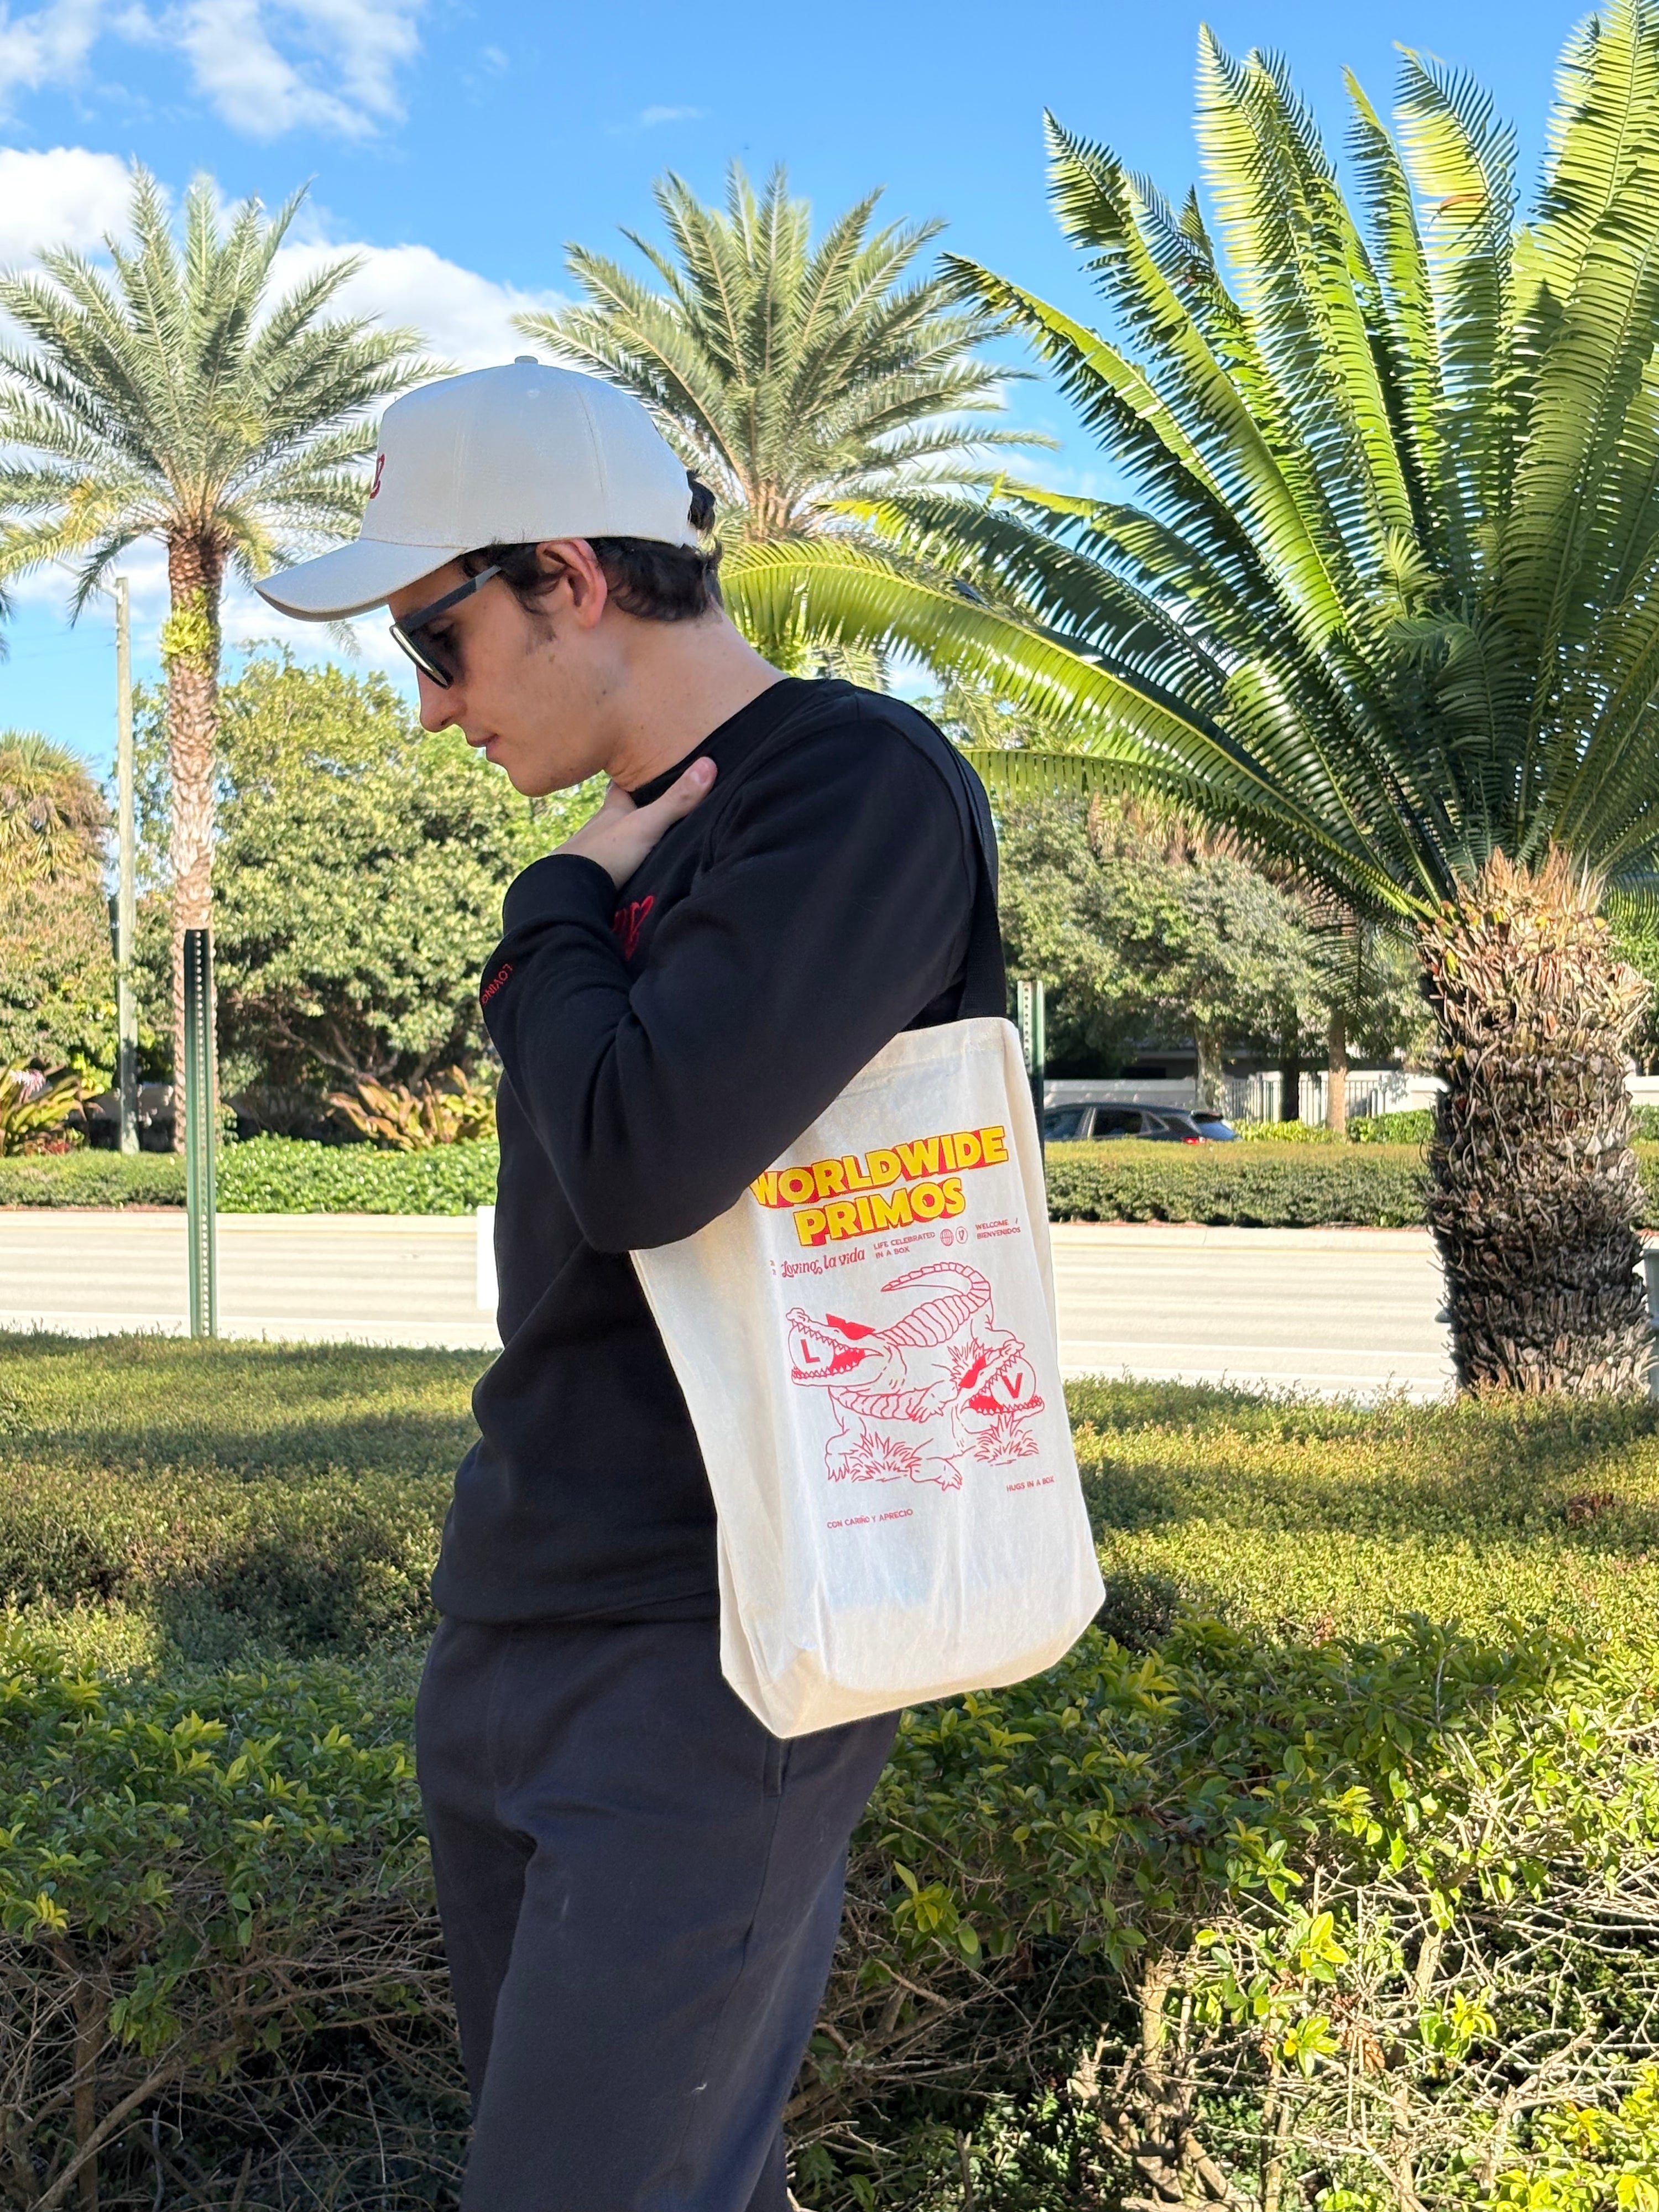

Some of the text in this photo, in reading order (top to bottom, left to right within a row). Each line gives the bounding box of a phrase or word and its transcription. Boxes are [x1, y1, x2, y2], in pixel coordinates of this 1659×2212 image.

[749, 1125, 1009, 1208] WORLDWIDE
[792, 1177, 966, 1247] PRIMOS
[975, 1219, 1009, 1231] WELCOME
[977, 1227, 1021, 1239] BIENVENIDOS
[873, 1232, 936, 1250] LIFE CELEBRATED
[894, 1246, 910, 1254] BOX
[781, 1260, 822, 1277] Loving
[823, 1255, 836, 1269] la
[838, 1247, 865, 1266] vida
[800, 1339, 821, 1364] L
[1001, 1372, 1023, 1399] V
[1006, 1482, 1025, 1492] HUGS
[1042, 1475, 1055, 1485] BOX
[827, 1520, 843, 1528] CON
[844, 1515, 870, 1526] CARIÑO
[879, 1508, 914, 1522] APRECIO
